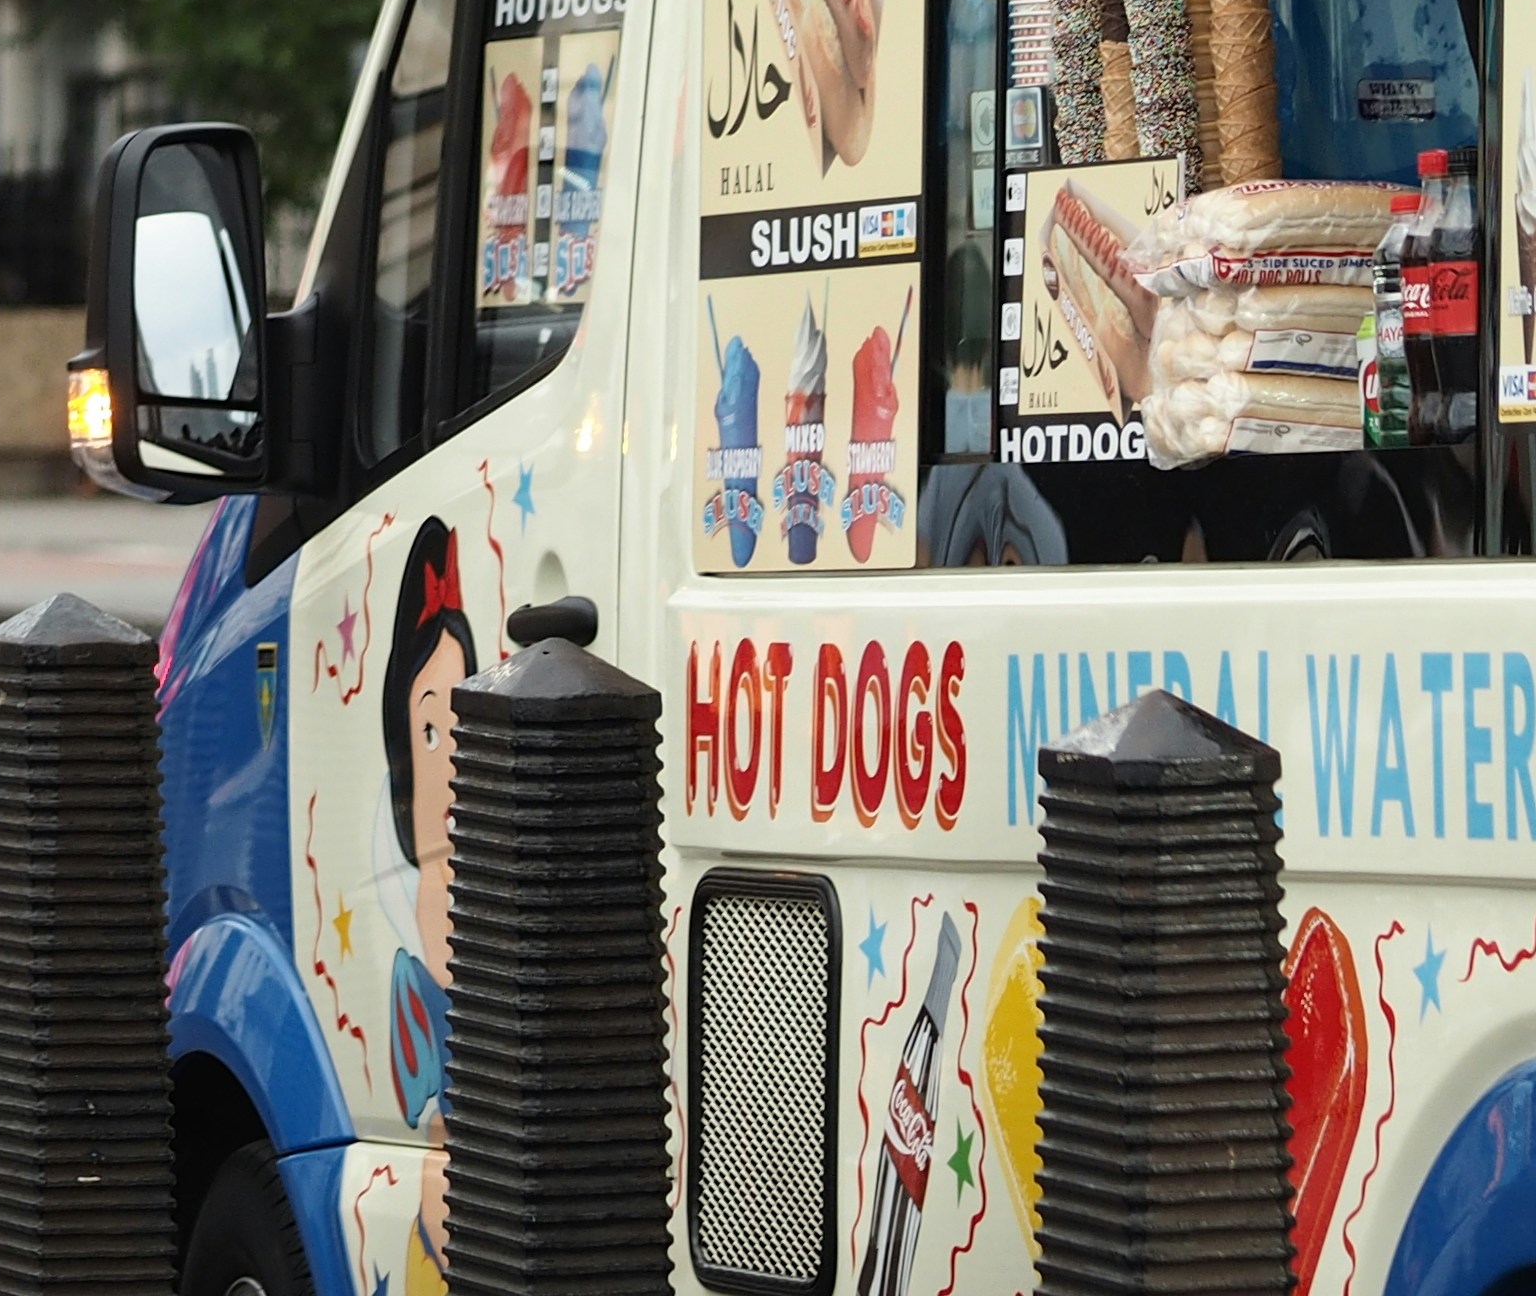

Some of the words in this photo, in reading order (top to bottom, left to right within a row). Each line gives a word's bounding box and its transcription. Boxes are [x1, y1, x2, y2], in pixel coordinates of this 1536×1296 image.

[720, 162, 775, 196] HALAL
[751, 211, 855, 267] SLUSH
[1292, 258, 1334, 269] SLICED
[1022, 298, 1069, 379] حلال
[1378, 327, 1404, 342] HAYA
[1028, 392, 1059, 408] HALAL
[1502, 374, 1525, 398] VISA
[785, 423, 825, 453] MIXED
[1000, 422, 1152, 463] HOTDOG
[773, 460, 836, 510] SLUSH
[704, 489, 764, 535] SLUSH
[840, 484, 905, 532] SLUSH
[686, 638, 793, 822] HOT
[811, 639, 967, 832] DOGS
[1007, 650, 1282, 829] MINAL
[888, 1078, 934, 1172] Coca-Cola
